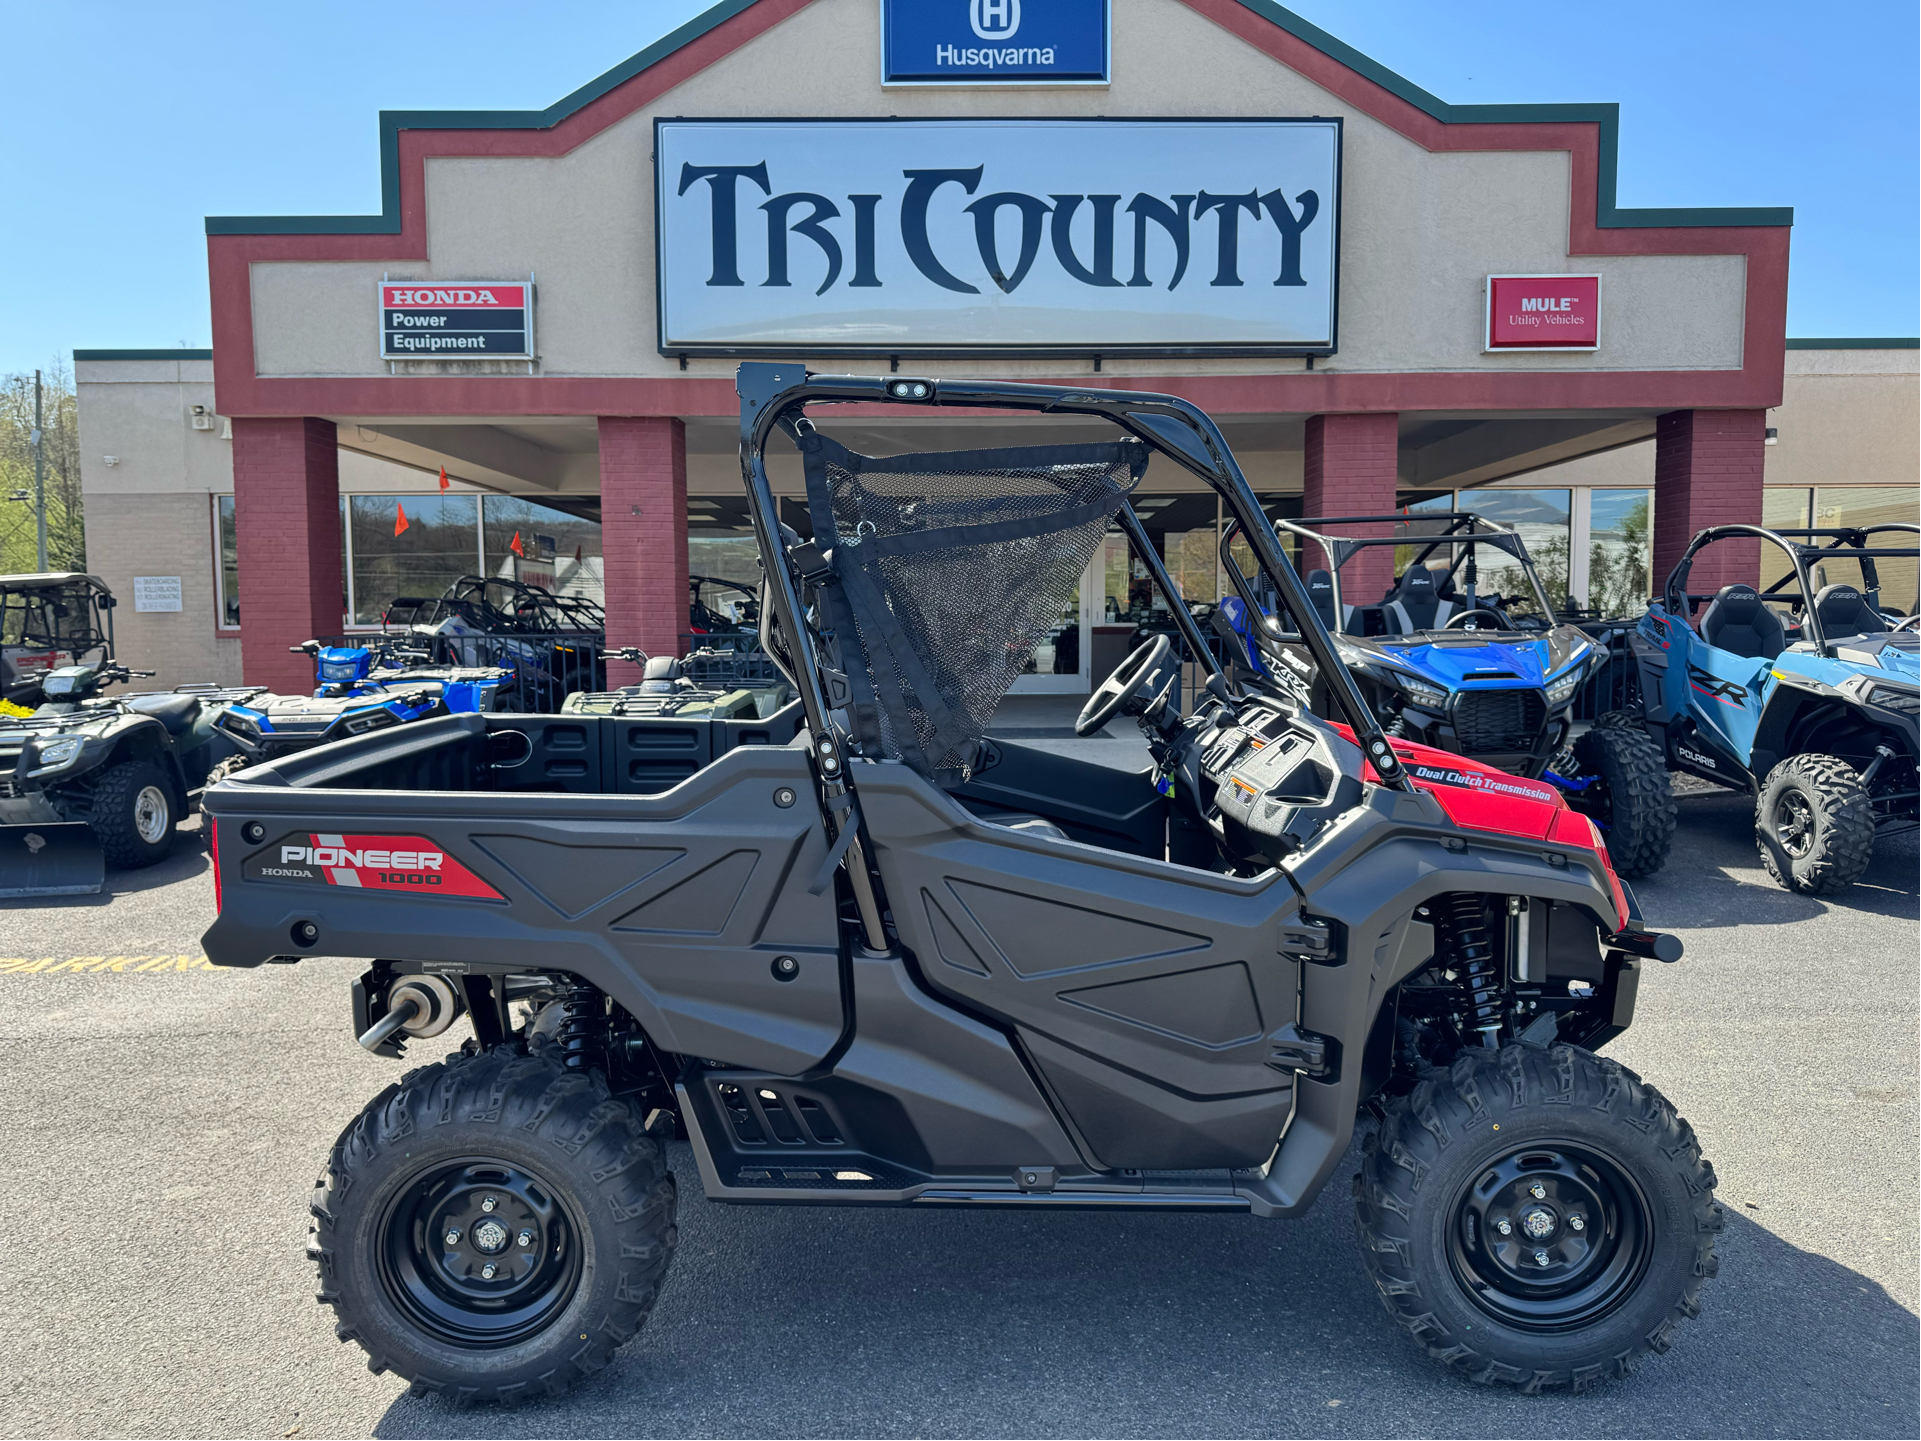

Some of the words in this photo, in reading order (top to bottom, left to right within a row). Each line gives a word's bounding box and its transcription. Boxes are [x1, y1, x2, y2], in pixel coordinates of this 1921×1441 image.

[936, 44, 1055, 69] Husqvarna
[678, 160, 884, 296] TRI
[900, 163, 1319, 295] COUNTY
[392, 290, 498, 304] HONDA
[392, 313, 447, 326] Power
[1509, 314, 1541, 327] Utility
[1544, 314, 1584, 325] Vehicles
[393, 334, 485, 351] Equipment
[1644, 628, 1662, 645] TRAIL
[1679, 747, 1716, 769] POLARIS
[1416, 766, 1443, 780] Dual
[1446, 772, 1483, 787] Clutch
[1484, 778, 1551, 801] Transmission
[281, 845, 444, 870] PIONEER
[261, 868, 313, 878] HONDA
[378, 872, 442, 885] 1000
